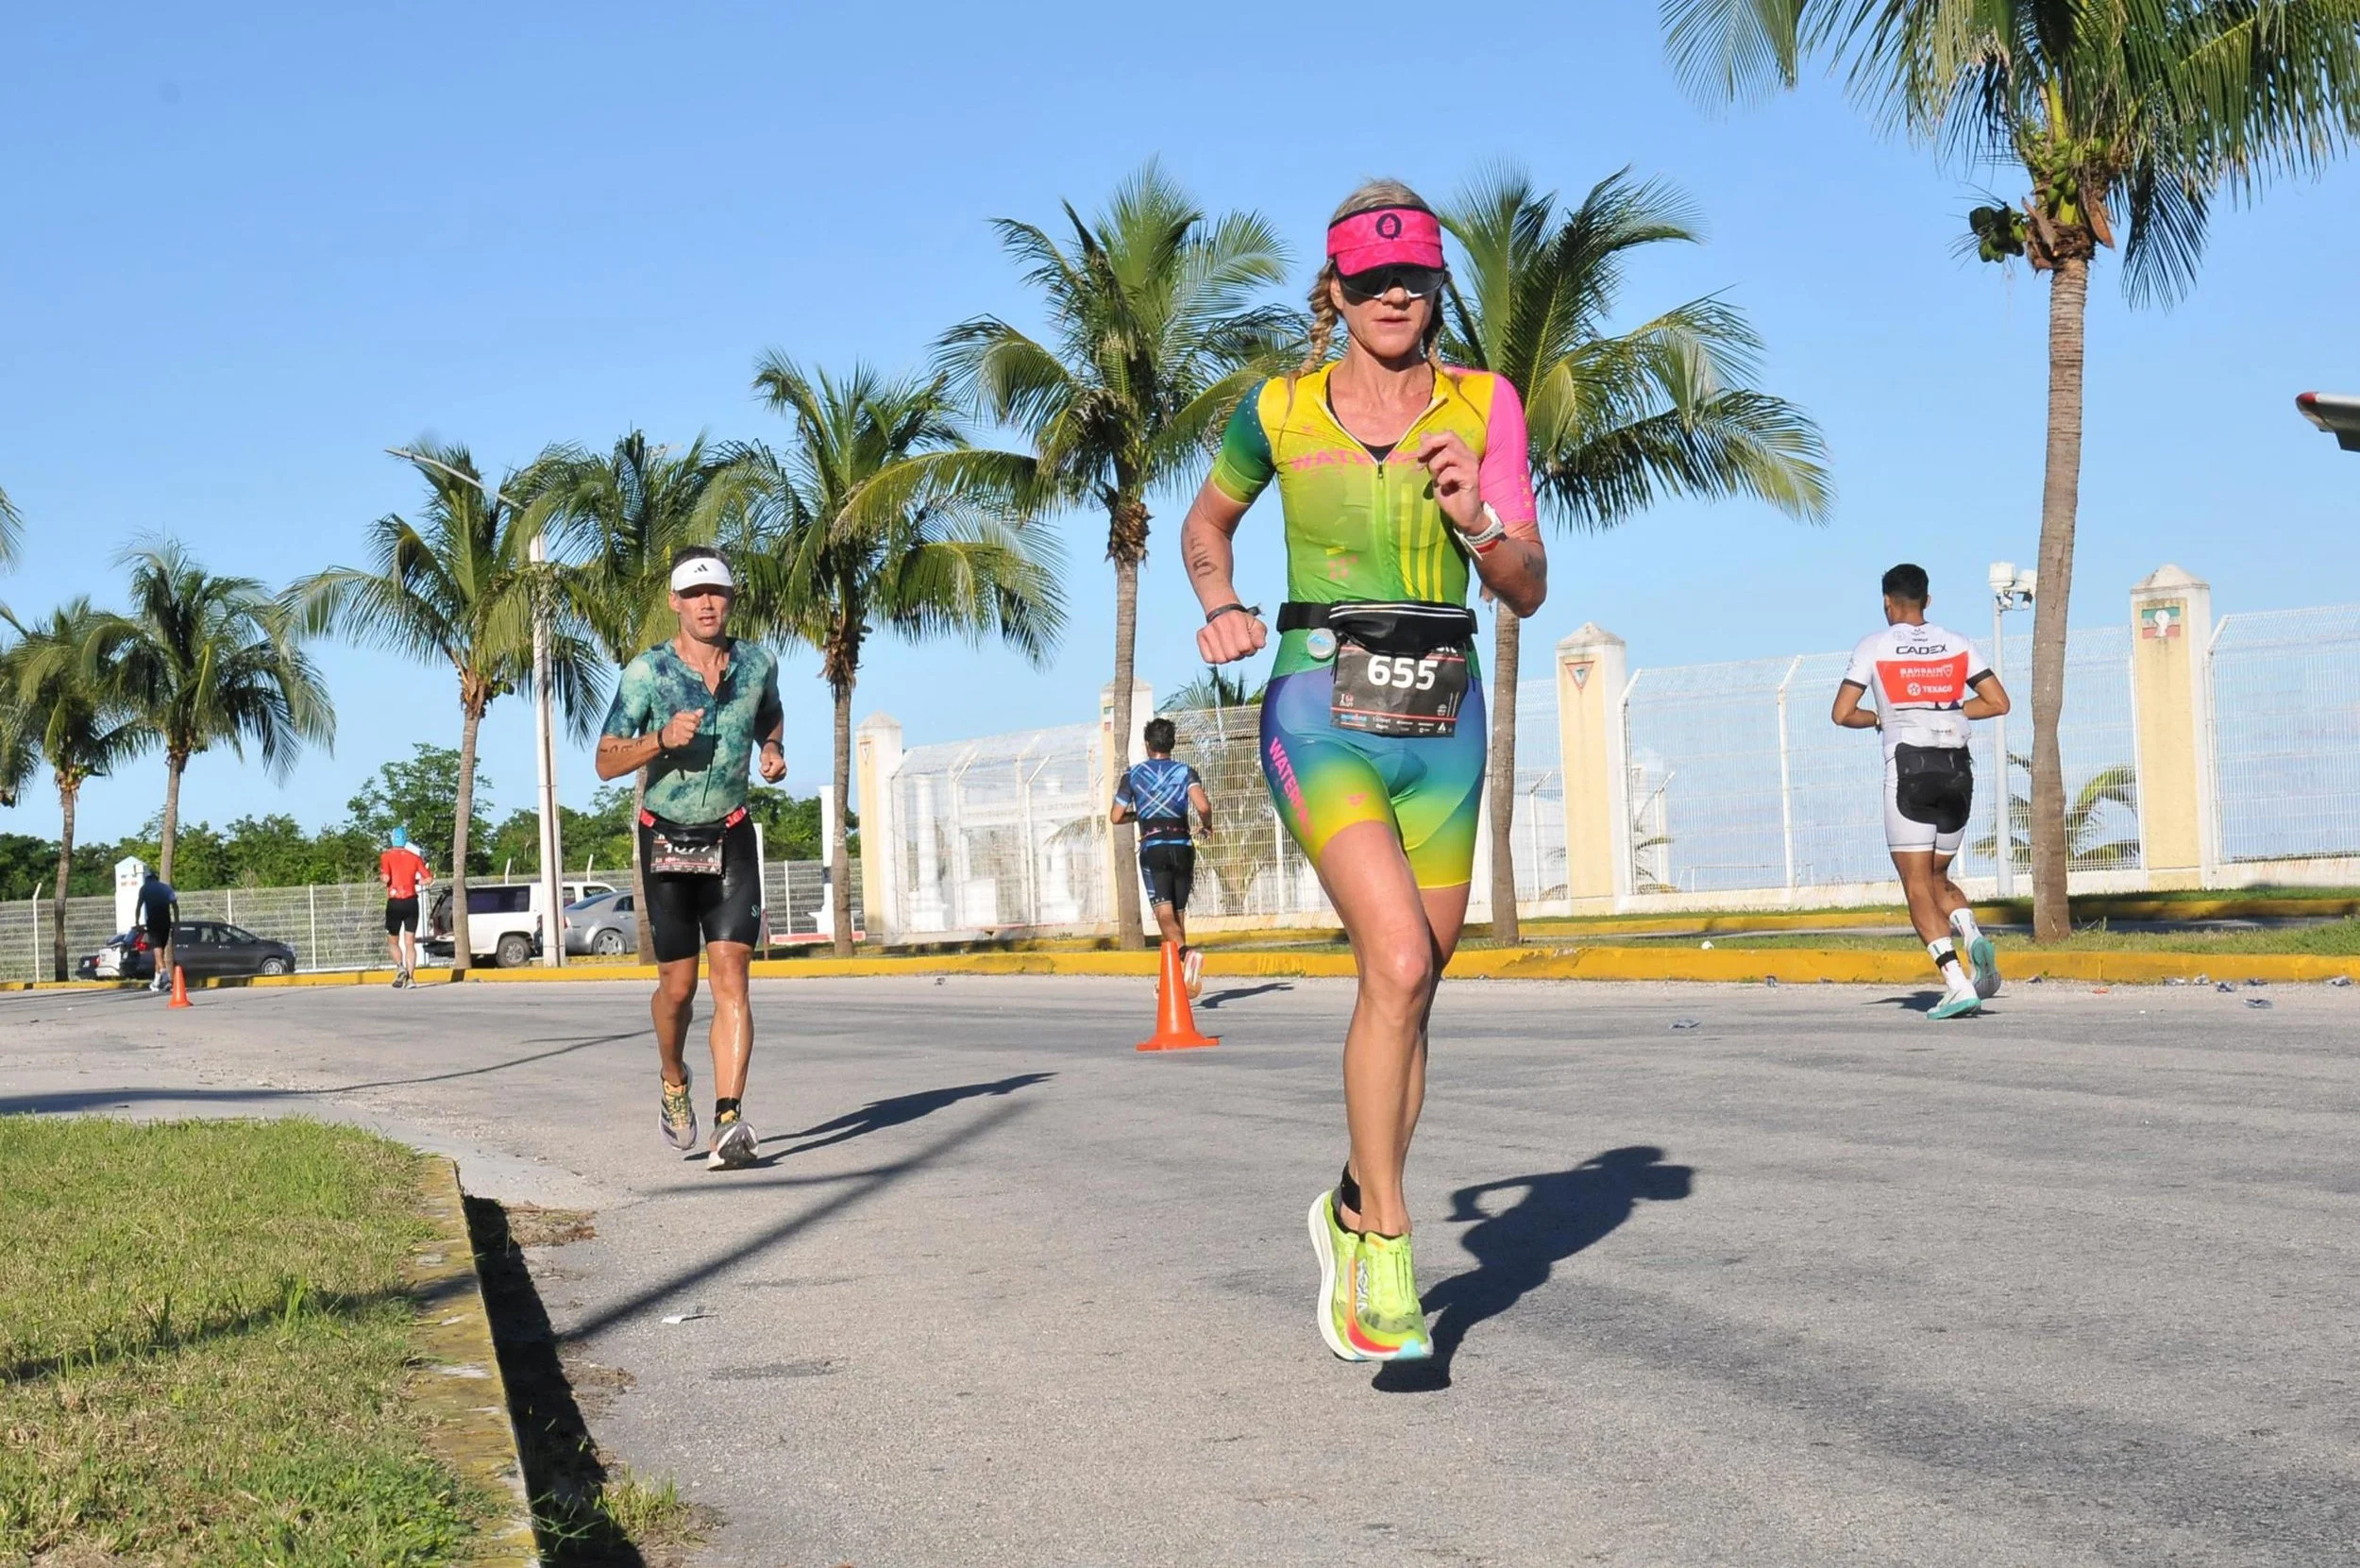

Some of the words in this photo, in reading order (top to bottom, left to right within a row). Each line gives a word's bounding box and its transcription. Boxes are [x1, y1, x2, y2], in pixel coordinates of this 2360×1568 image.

[1896, 644, 1947, 655] CADEX
[1368, 654, 1438, 691] 655
[1923, 684, 1953, 694] TEXACO
